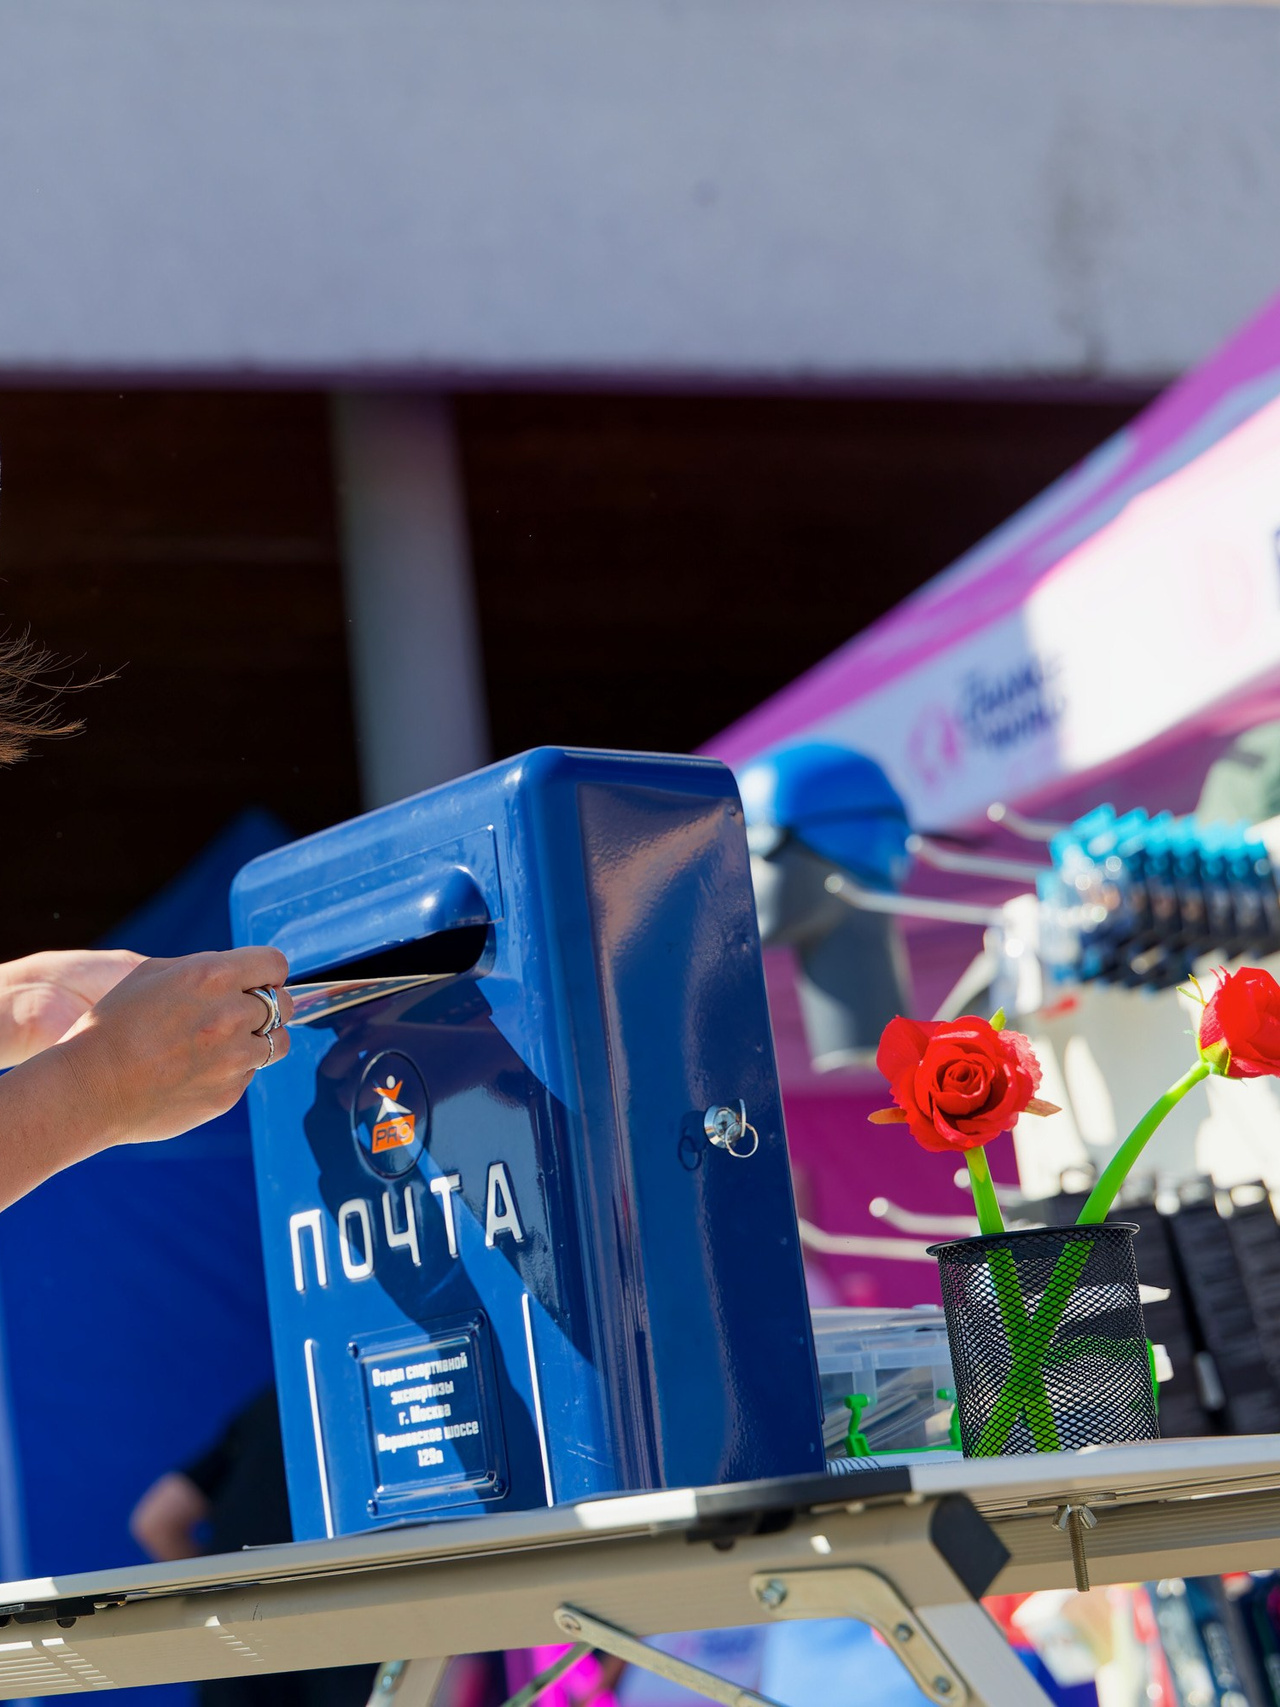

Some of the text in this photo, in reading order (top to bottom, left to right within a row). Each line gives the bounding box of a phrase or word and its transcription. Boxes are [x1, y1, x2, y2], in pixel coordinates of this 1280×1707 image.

[375, 1122, 412, 1147] PRO
[289, 1162, 524, 1293] ПОЧТА
[372, 1352, 468, 1387] Отдел спортивной
[390, 1380, 454, 1405] экспертизы
[399, 1404, 451, 1426] г. Москва
[377, 1421, 479, 1453] Варшавское шоссе
